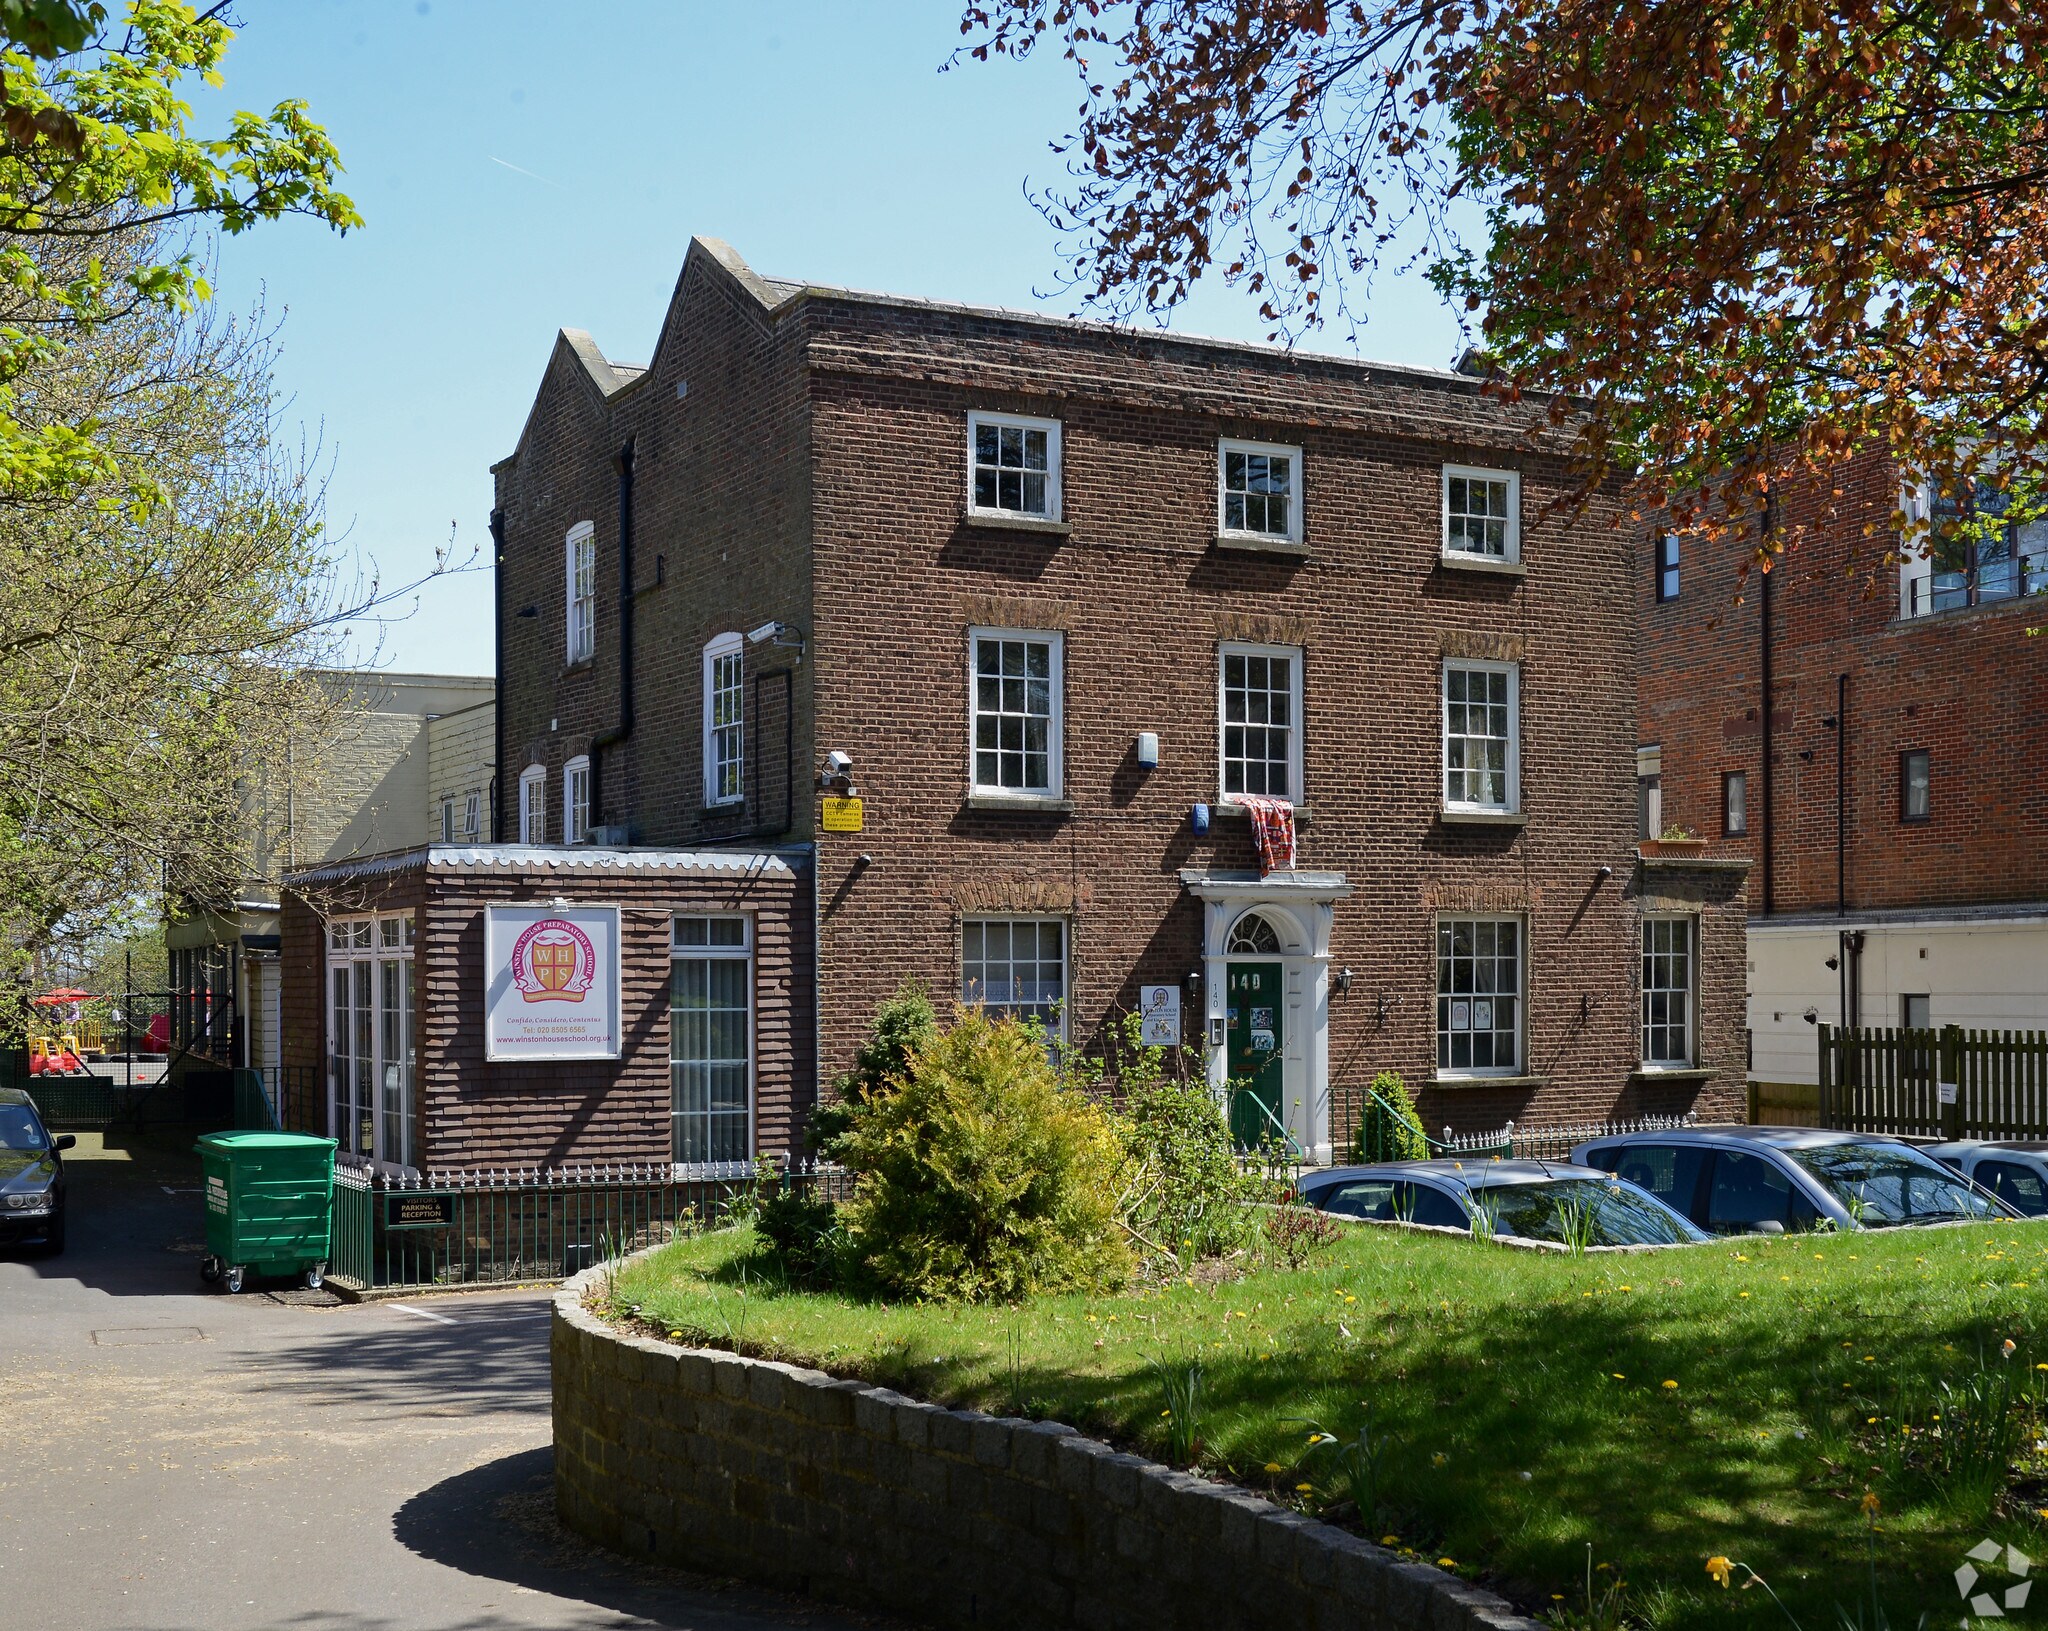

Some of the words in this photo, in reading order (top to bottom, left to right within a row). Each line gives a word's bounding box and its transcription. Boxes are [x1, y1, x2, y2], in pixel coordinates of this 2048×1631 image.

[825, 801, 860, 809] WARNING
[514, 944, 524, 976] WINSTON
[521, 924, 543, 943] HOUSE
[543, 921, 588, 946] PREPARATORY
[585, 945, 594, 976] SCHOOL
[535, 949, 551, 962] W
[557, 949, 569, 962] H
[540, 968, 549, 980] P
[559, 968, 568, 981] S
[522, 1026, 535, 1034] Tel:
[496, 1034, 612, 1043] www.winstonhouseschool.org.uk
[401, 1210, 442, 1218] RECEPTION
